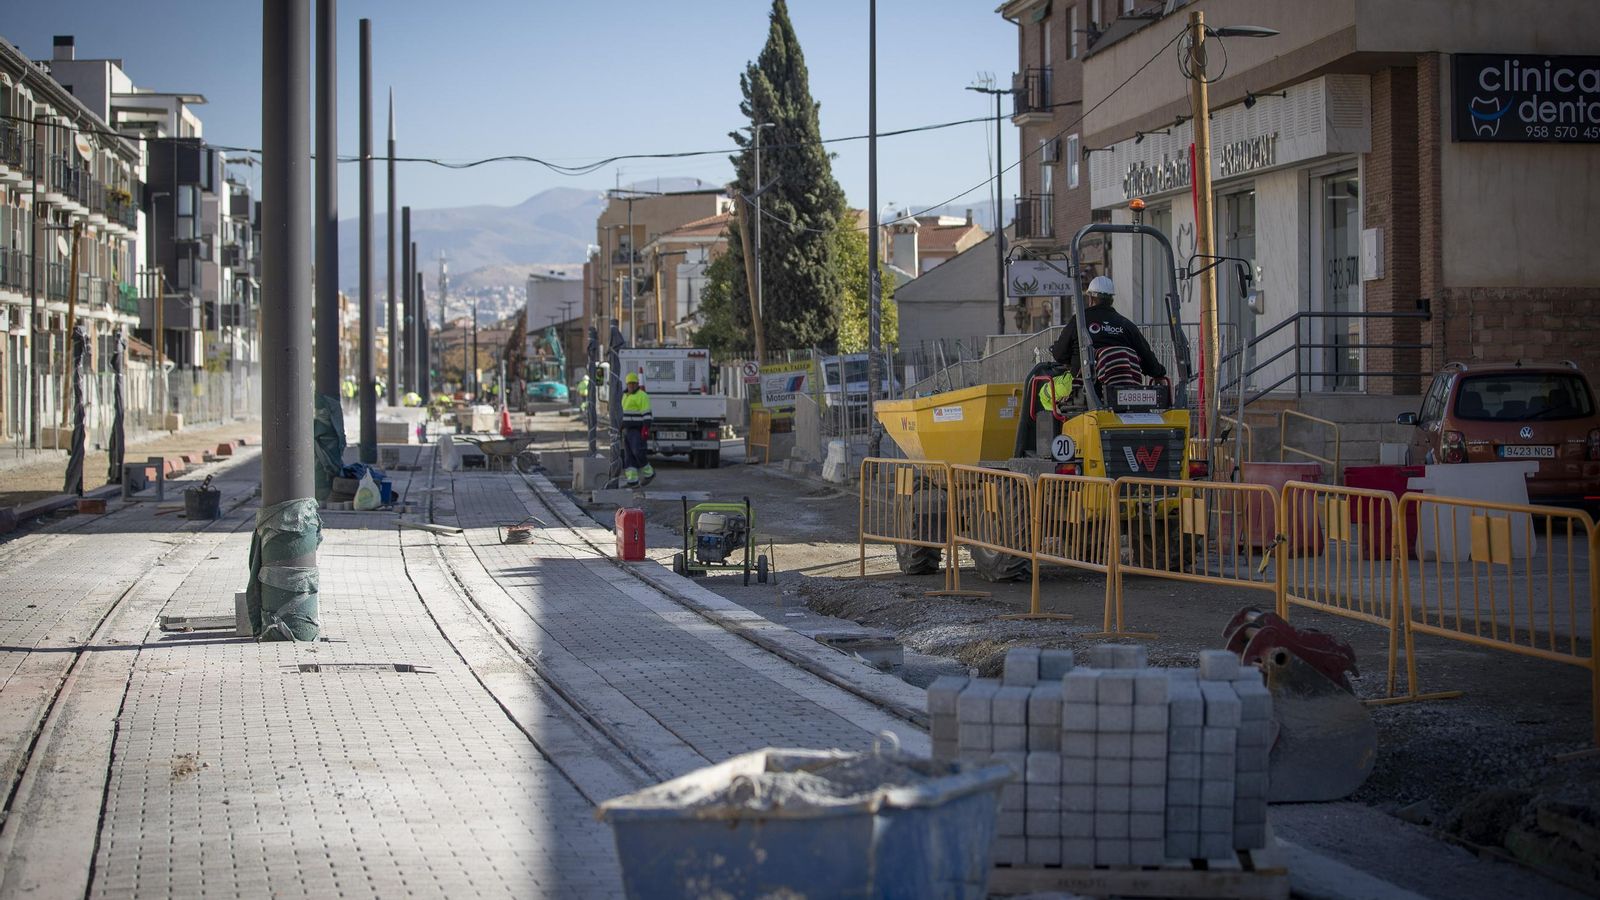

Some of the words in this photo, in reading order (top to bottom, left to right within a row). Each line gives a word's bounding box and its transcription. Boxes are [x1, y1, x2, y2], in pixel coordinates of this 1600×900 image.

[1478, 59, 1600, 93] clinica
[1525, 126, 1549, 138] 958
[1554, 126, 1578, 138] 570
[1583, 127, 1600, 139] 45
[1328, 258, 1344, 290] 958
[1057, 439, 1069, 456] 20
[1506, 446, 1532, 456] 9423
